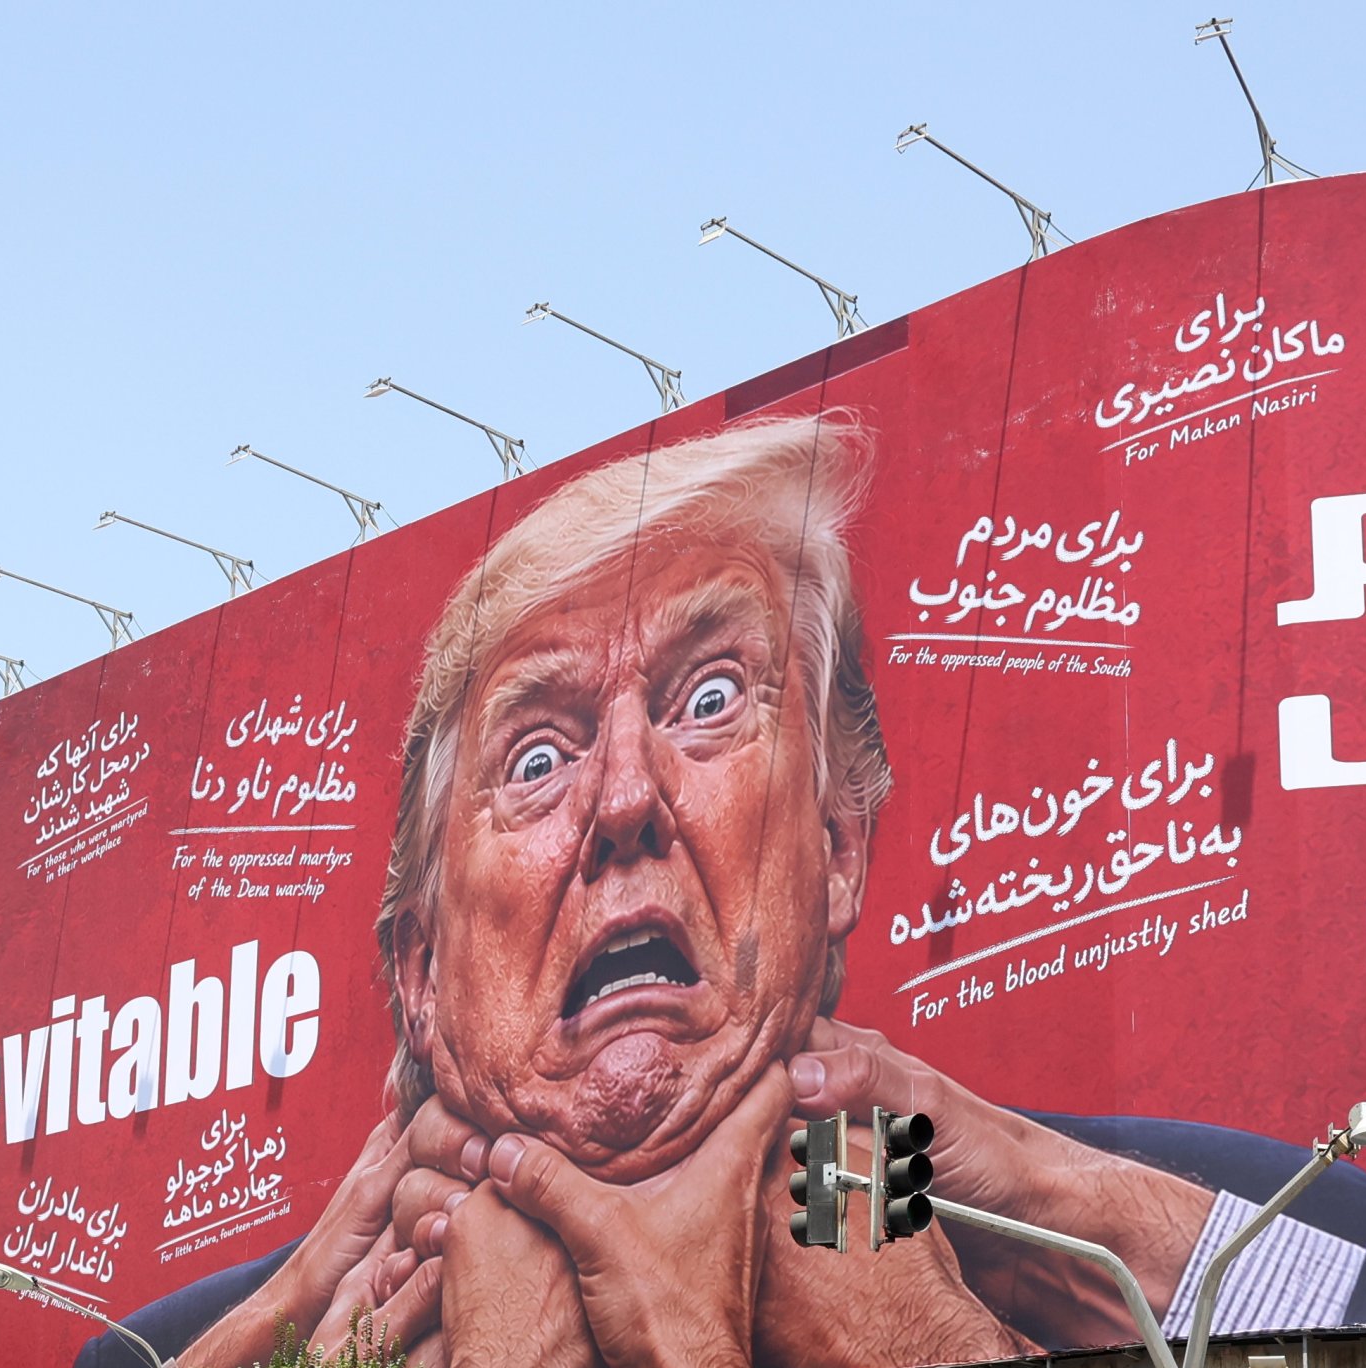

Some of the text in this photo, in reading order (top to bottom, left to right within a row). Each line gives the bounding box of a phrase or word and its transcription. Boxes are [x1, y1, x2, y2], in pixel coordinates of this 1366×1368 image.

[1176, 292, 1265, 353] برای
[1095, 321, 1345, 428] ماکان نصیری
[1126, 385, 1316, 466] For Makan Nasiri
[956, 510, 1144, 572] برای مردم
[909, 568, 1141, 634] مظلوم جنوب
[889, 646, 1131, 677] For the oppressed people of the South
[100, 711, 138, 751] برای
[226, 694, 357, 753] برای شهدای
[23, 742, 150, 825] در محل کارشان
[36, 738, 65, 779] که
[191, 756, 357, 819] مظلوم ناو دنا
[27, 804, 147, 878] For those who were martyred
[35, 778, 130, 845] شهید شدند
[46, 836, 121, 883] in their workplace
[172, 845, 352, 874] For the oppressed martyrs
[189, 876, 324, 903] of the Dena warship
[912, 889, 1248, 1026] For the blood unjustly shed
[201, 1109, 246, 1151] برای
[165, 1127, 285, 1203] زهرا کوچولو
[18, 1175, 127, 1246] برای مادران
[163, 1171, 283, 1231] چهارده ماهه
[4, 1225, 114, 1283] داغدار ایران
[160, 1242, 175, 1263] For
[175, 1240, 192, 1257] little
[220, 1202, 290, 1239] fourteen-month-old
